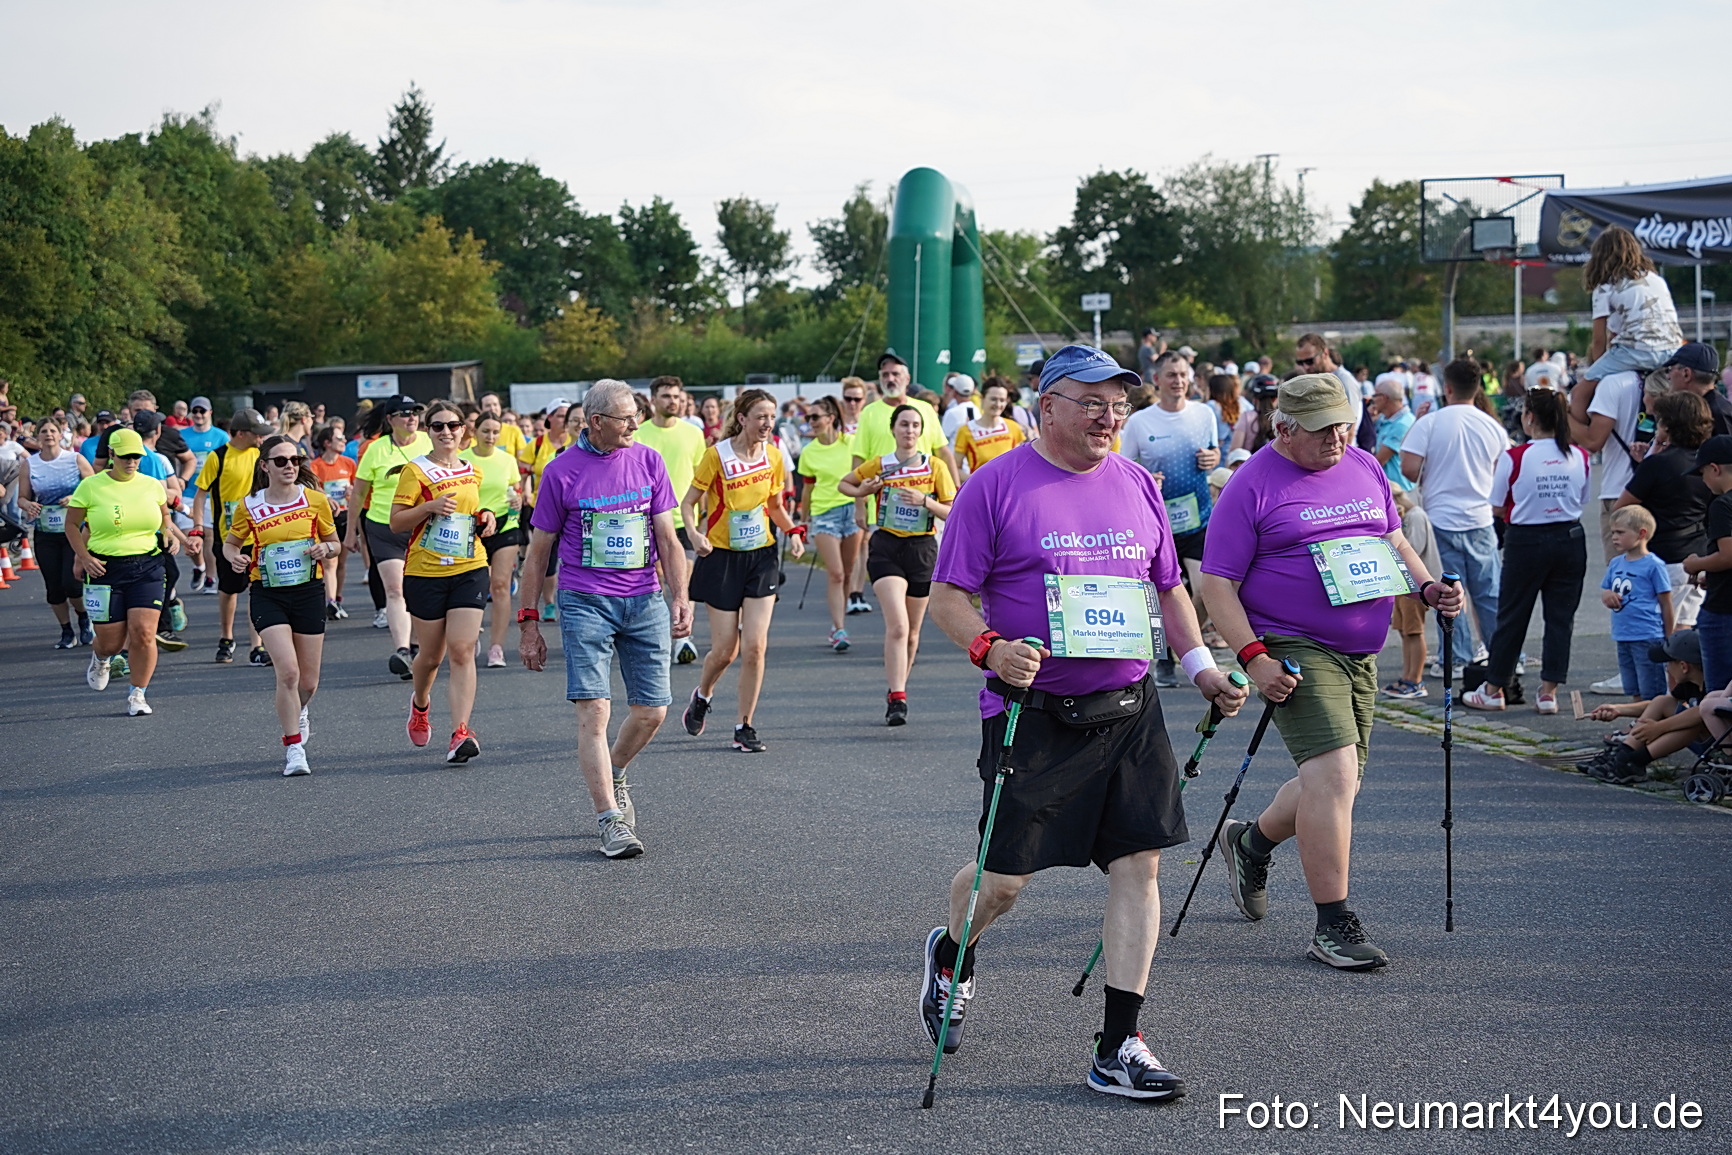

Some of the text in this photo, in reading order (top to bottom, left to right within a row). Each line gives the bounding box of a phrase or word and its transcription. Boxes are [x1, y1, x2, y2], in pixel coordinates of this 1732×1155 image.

[1634, 212, 1689, 249] Hier
[436, 480, 460, 492] MAX
[726, 478, 749, 491] MAX
[578, 490, 639, 509] Diakonie
[895, 505, 919, 517] 1863
[1171, 510, 1189, 521] 323
[1299, 498, 1370, 520] diakonie
[1359, 506, 1386, 521] nah
[257, 510, 312, 533] MAX BÖGL
[439, 527, 460, 540] 1818
[739, 524, 761, 537] 1799
[606, 536, 633, 548] 686
[1041, 528, 1127, 549] diakonie
[1112, 543, 1146, 560] nah
[275, 558, 302, 571] 1666
[1349, 560, 1378, 576] 687
[1350, 577, 1374, 586] Thomas
[1085, 608, 1126, 626] 694
[1072, 629, 1143, 639] Marko Hegelheimer
[1153, 630, 1161, 654] HILTL
